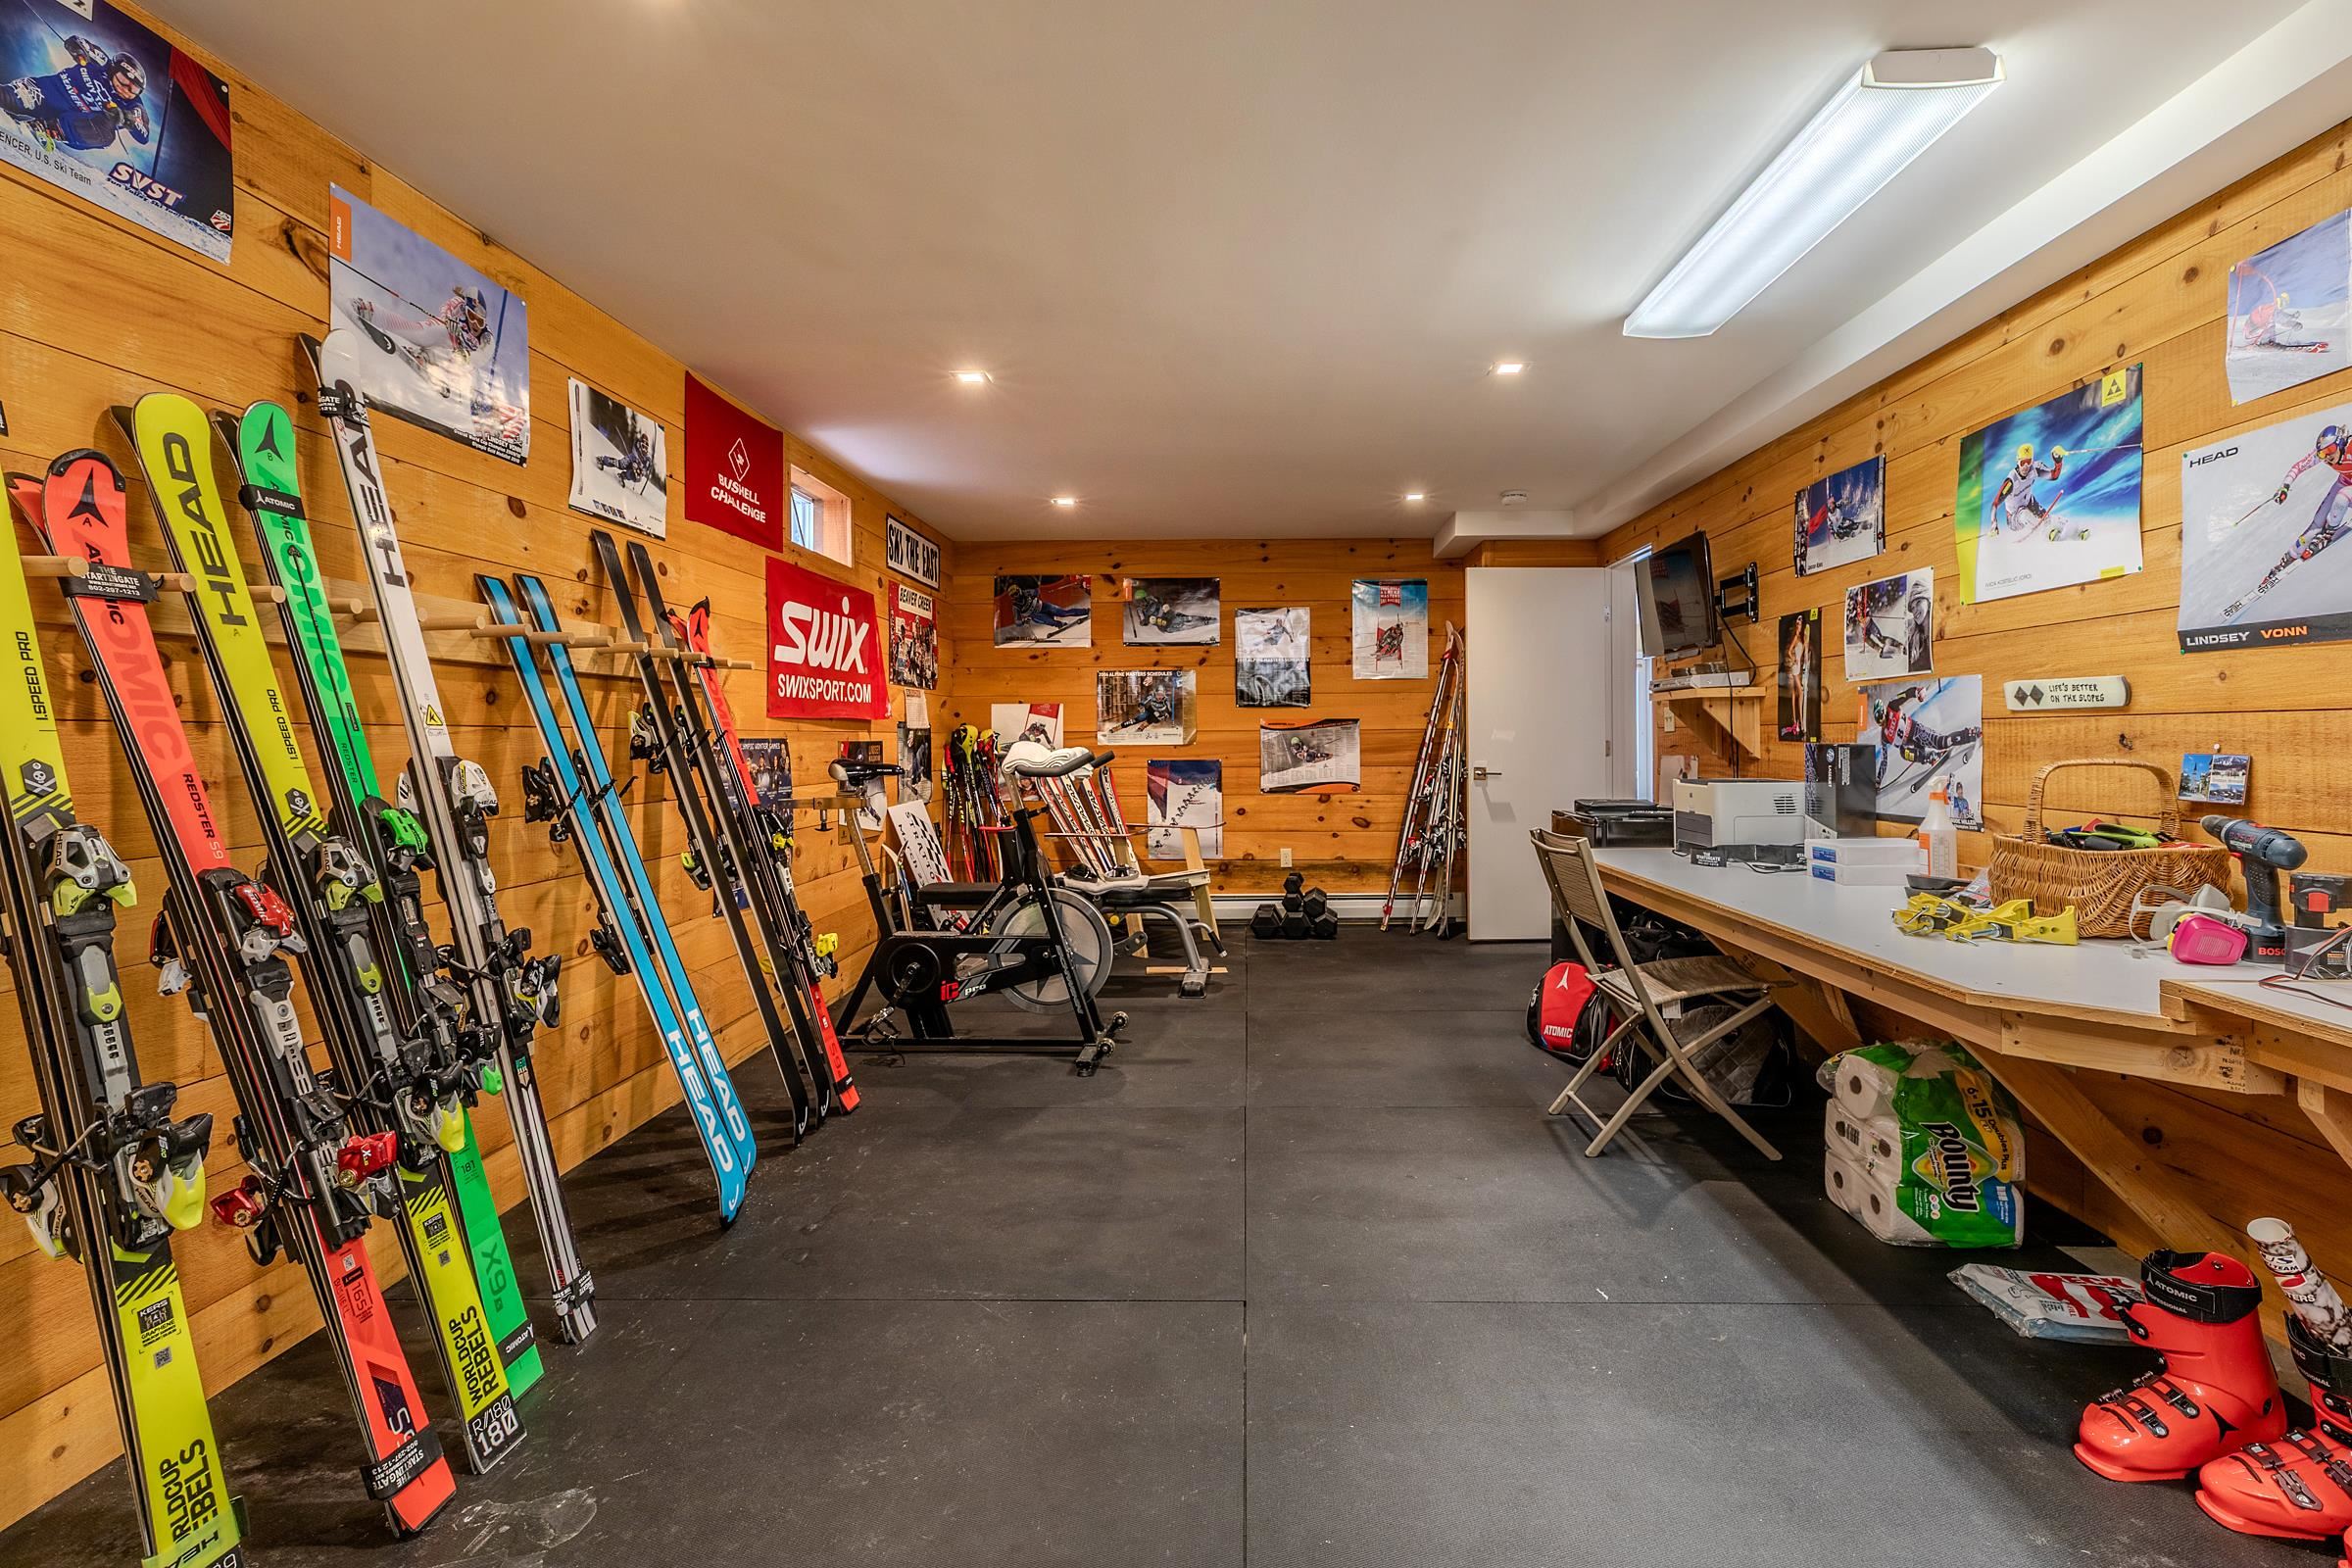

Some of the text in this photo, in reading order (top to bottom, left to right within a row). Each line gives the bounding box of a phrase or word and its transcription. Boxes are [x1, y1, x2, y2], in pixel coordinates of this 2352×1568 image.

[35, 144, 51, 167] U.S.
[53, 159, 68, 174] Ski
[69, 169, 92, 186] Team
[110, 162, 184, 207] SVST
[2189, 447, 2239, 468] HEAD
[264, 496, 296, 510] ATOMIC
[718, 473, 760, 505] BUSHELL
[710, 486, 766, 523] CHALLENGE
[164, 432, 248, 628] HEAD
[888, 523, 938, 583] SKI THE EAST
[99, 565, 117, 575] THE
[88, 585, 141, 596] 802-297-1213
[900, 588, 932, 613] BEAVER CREEK
[16, 631, 34, 662] PRO
[2186, 626, 2308, 646] LINDSEY VONN
[267, 688, 288, 712] PRO
[778, 673, 872, 703] SWIXSPORT.COM
[2049, 683, 2099, 692] LIFE'S BETTER
[2079, 693, 2105, 703] SLOPES
[341, 742, 358, 784] REDSTER
[183, 773, 224, 860] REDSTER S9
[54, 833, 63, 868] HEAD
[322, 845, 331, 872] HEAD
[2258, 947, 2285, 956] BOSC
[964, 983, 987, 996] pro
[1544, 1025, 1573, 1039] ATOMIC
[687, 1007, 745, 1142] HEAD
[667, 1029, 734, 1172] HEAD
[1988, 1119, 2009, 1152] Doubles
[2001, 1153, 2009, 1171] Plus
[461, 1160, 476, 1175] 181
[1918, 1121, 1981, 1212] Bounty
[135, 1187, 159, 1213] HEAD
[53, 1205, 64, 1236] HEAD
[481, 1243, 508, 1297] X9
[351, 1282, 368, 1312] 165
[2146, 1292, 2188, 1314] ROFESSIONAL
[2154, 1279, 2198, 1303] ATOMIC
[139, 1299, 169, 1317] KERS
[141, 1320, 176, 1340] GRAPHENE
[505, 1330, 530, 1354] ATOMIC
[449, 1319, 484, 1408] WORLDCUP
[460, 1305, 499, 1397] REBELS
[477, 1408, 518, 1456] 180
[371, 1441, 418, 1474] 802-297-1213
[373, 1450, 424, 1490] STARTINGATE
[396, 1472, 412, 1488] THE
[160, 1459, 192, 1544] RLDCUP
